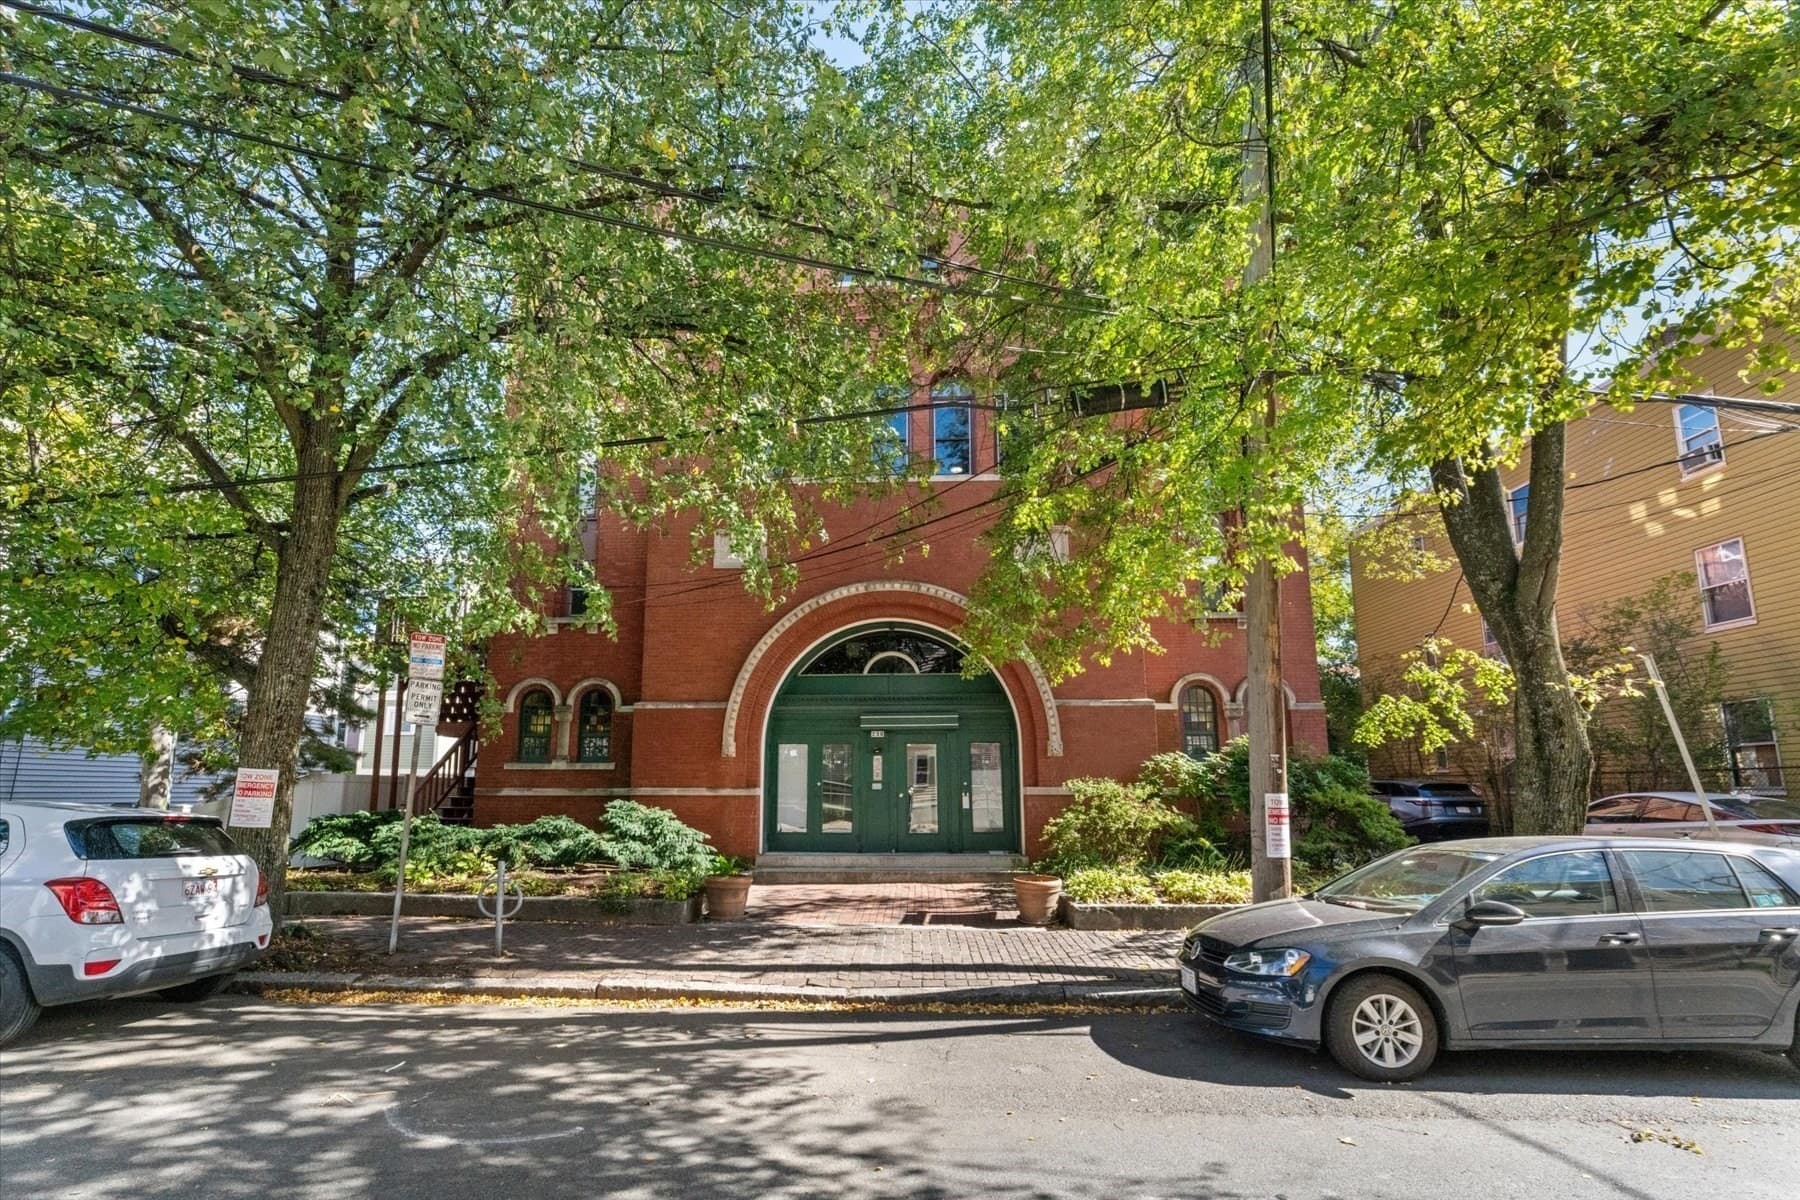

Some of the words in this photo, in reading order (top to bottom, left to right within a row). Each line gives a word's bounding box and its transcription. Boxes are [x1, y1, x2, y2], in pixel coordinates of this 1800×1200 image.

[410, 680, 441, 691] PARKING
[411, 693, 437, 702] PERMIT
[413, 701, 433, 710] ONLY
